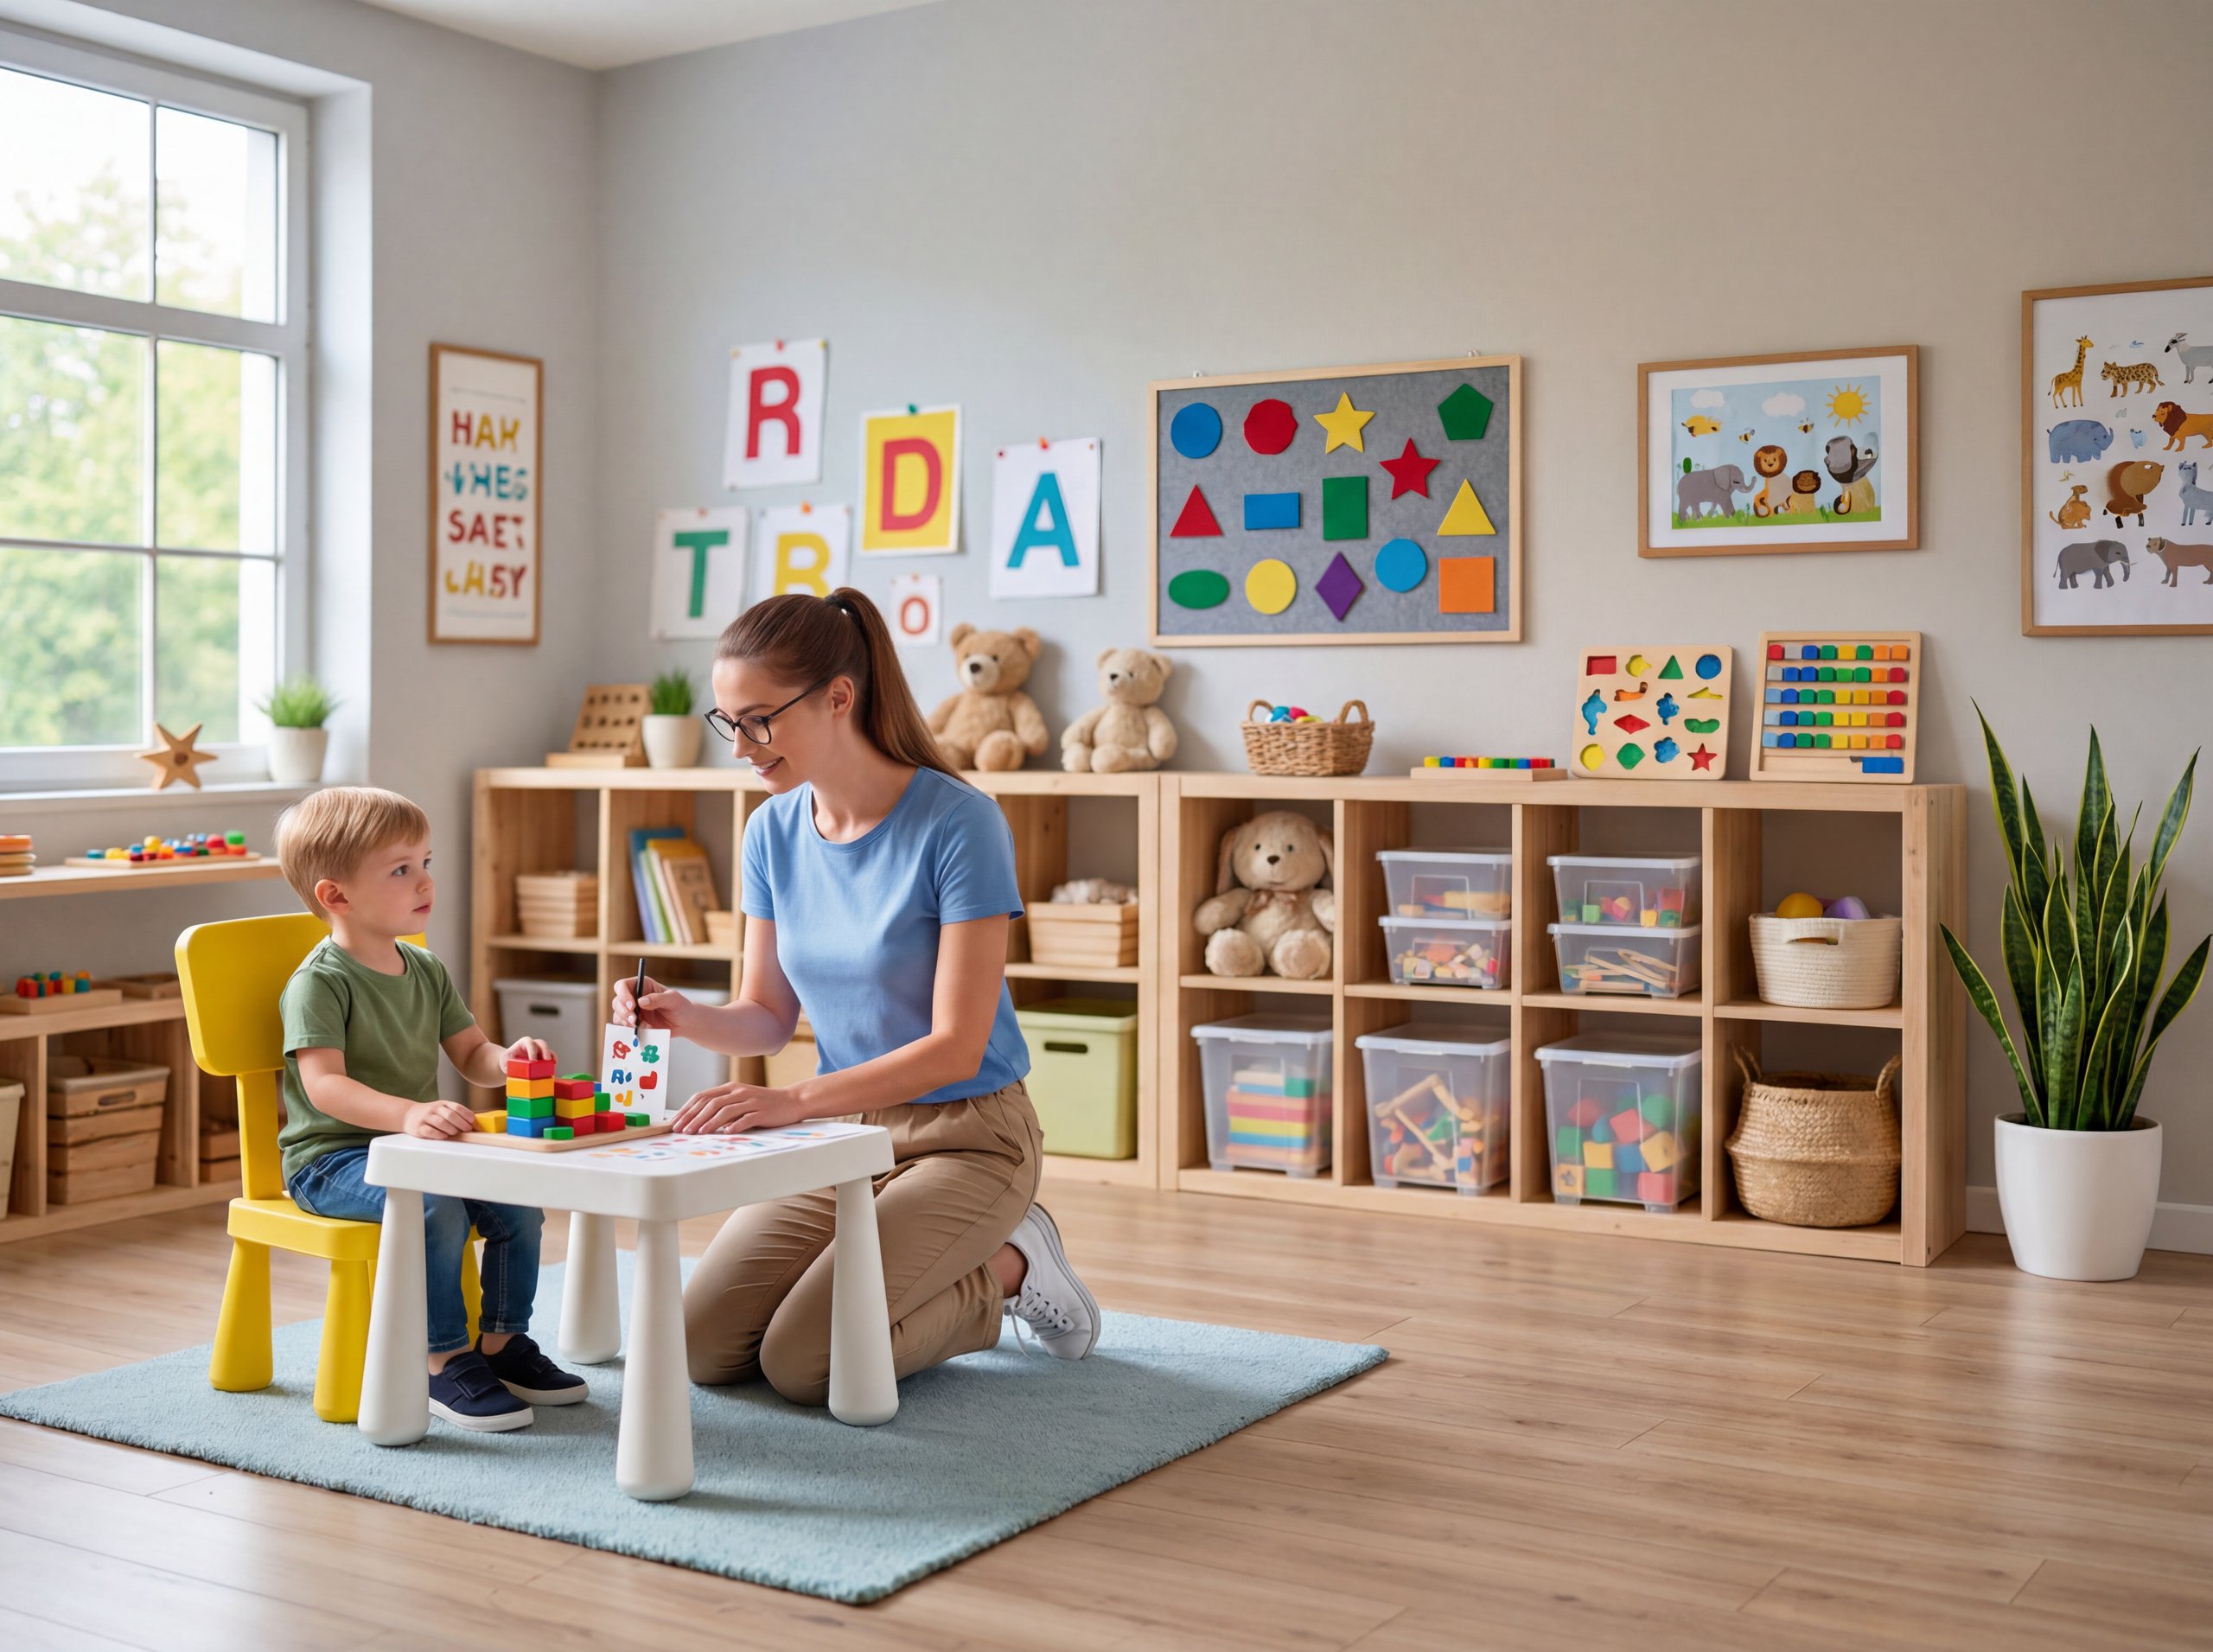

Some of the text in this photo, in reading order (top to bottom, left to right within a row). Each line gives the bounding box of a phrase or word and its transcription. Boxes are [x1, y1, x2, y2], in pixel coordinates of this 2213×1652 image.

[745, 366, 801, 459] R
[881, 437, 941, 531] D
[1007, 472, 1080, 569] A
[674, 530, 729, 617] T
